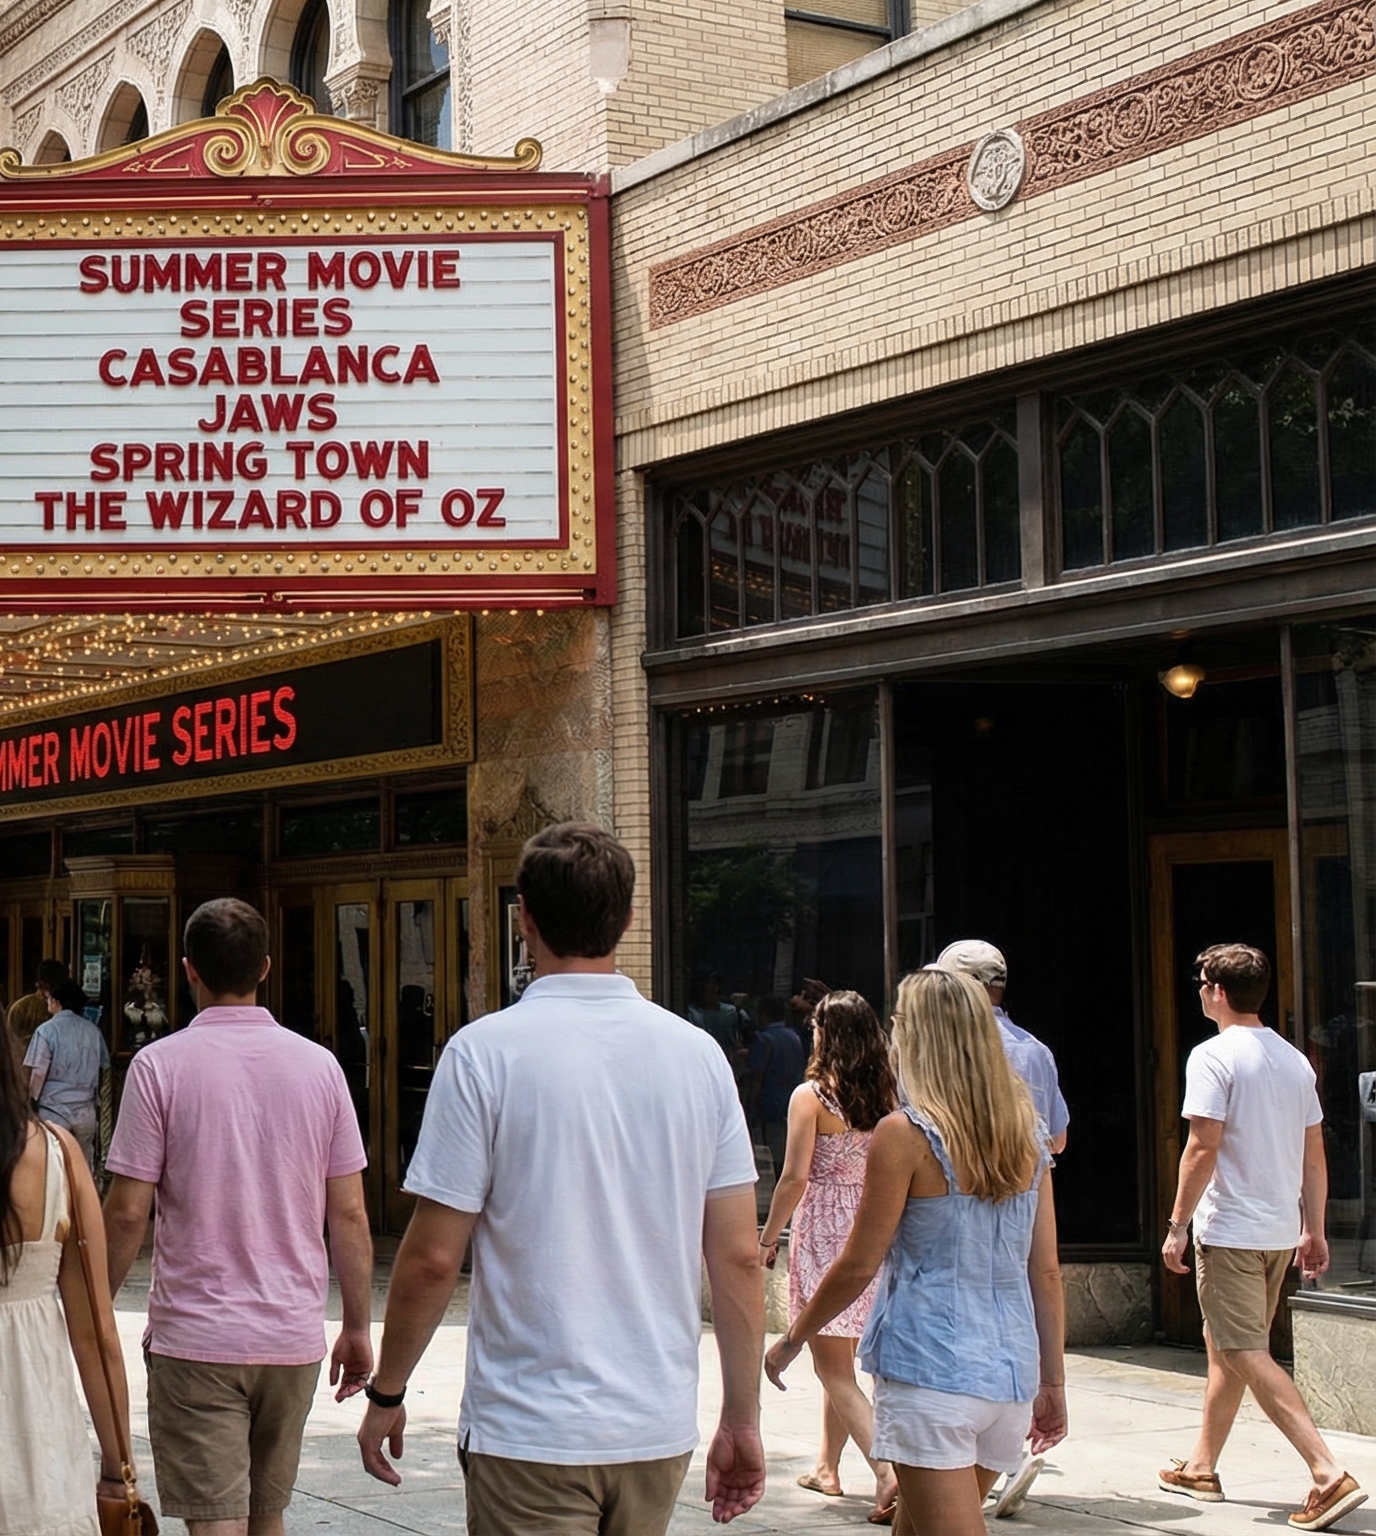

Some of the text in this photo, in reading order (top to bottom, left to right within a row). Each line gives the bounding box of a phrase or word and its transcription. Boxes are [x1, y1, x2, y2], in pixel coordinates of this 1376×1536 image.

[79, 250, 460, 294] SUMMER MOVIE
[180, 298, 353, 338] SERIES
[99, 344, 440, 387] CASABLANCA
[198, 393, 337, 433] JAWS
[90, 440, 429, 482] SPRING TOWN
[35, 488, 506, 531] THE WIZARD OF OZ
[70, 711, 161, 779] MOVIE
[172, 685, 297, 766] SERIES
